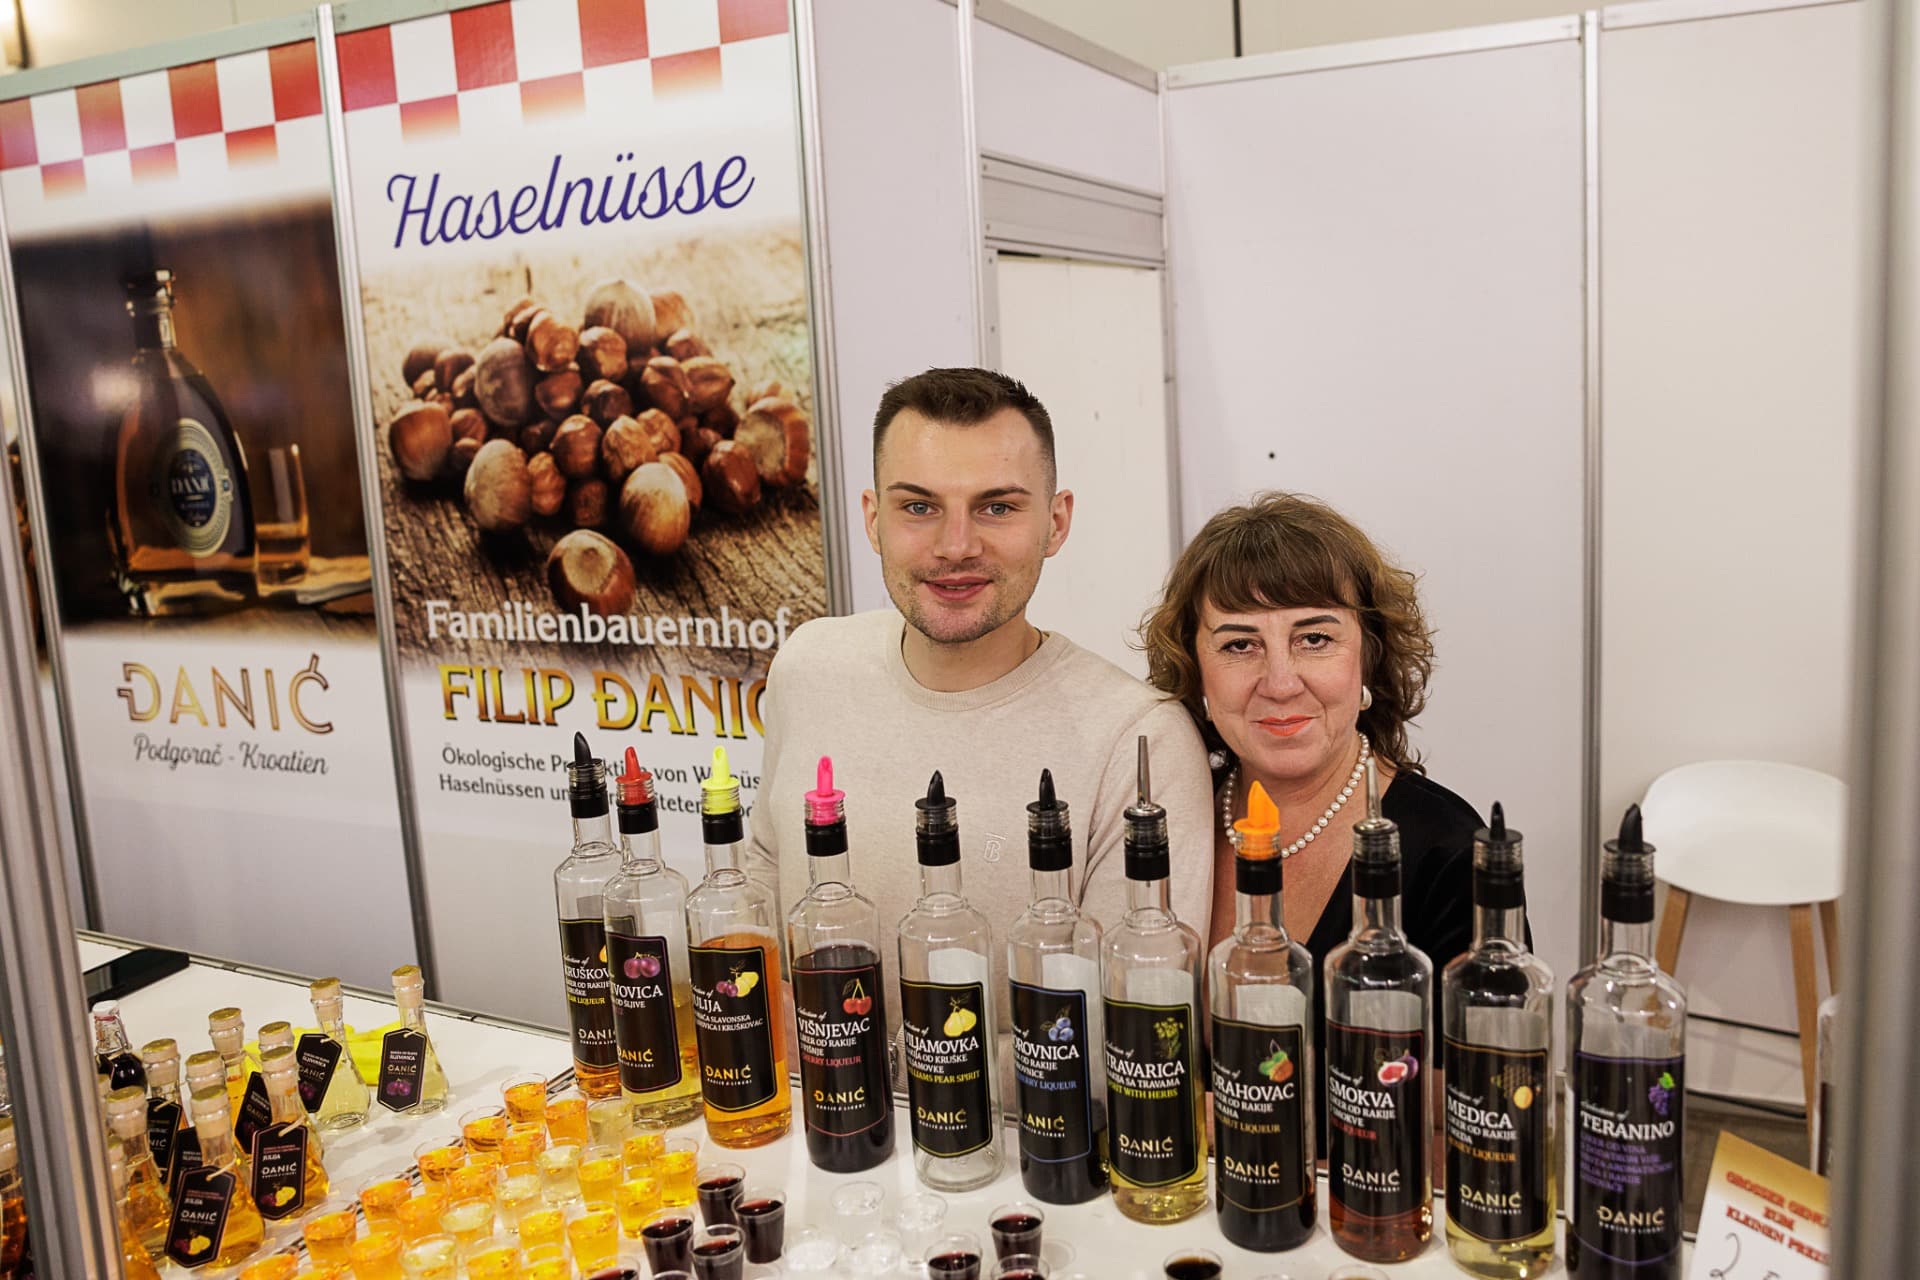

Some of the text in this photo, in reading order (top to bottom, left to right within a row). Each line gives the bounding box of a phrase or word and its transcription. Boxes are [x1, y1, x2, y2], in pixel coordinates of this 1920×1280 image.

[387, 152, 755, 248] Haselnüsse
[425, 600, 792, 650] Familienbauernhof
[117, 653, 334, 735] ĐANIĆ
[438, 664, 575, 727] FILIP
[134, 733, 223, 770] Podgorač
[239, 741, 329, 775] Kroatien
[442, 744, 546, 773] Ökologische
[654, 767, 688, 783] von
[440, 774, 544, 799] Haselnüssen
[550, 786, 570, 801] un
[565, 966, 610, 980] KRUŠKOV
[613, 983, 664, 999] VOVICA
[694, 993, 722, 1014] ULIJA
[798, 1017, 871, 1040] VIŠNJEVAC
[829, 1037, 857, 1048] RAKIJE
[1013, 1035, 1080, 1060] OROVNICA
[826, 1056, 862, 1068] LIQUEUR
[923, 1053, 934, 1063] OD
[1030, 1058, 1058, 1071] RAKIJE
[1106, 1051, 1185, 1079] TRAVARICA
[705, 1064, 752, 1080] ĐANIĆ
[934, 1074, 955, 1083] PEAR
[957, 1069, 981, 1082] SPIRIT
[1039, 1081, 1077, 1092] LIQUEUR
[1137, 1077, 1181, 1089] TRAVAMA
[814, 1086, 866, 1104] ĐANIĆ
[1123, 1086, 1146, 1099] WITH
[1148, 1087, 1179, 1100] HERBS
[1329, 1077, 1395, 1109] SMOKVA
[917, 1106, 968, 1124] ĐANIĆ
[1241, 1101, 1273, 1113] RAKIJE
[1348, 1103, 1361, 1115] OD
[1362, 1108, 1397, 1120] RAKIJE
[1448, 1095, 1513, 1129] MEDICA
[1026, 1113, 1065, 1131] ANIĆ
[1240, 1123, 1281, 1134] LIQUEUR
[1580, 1110, 1675, 1140] TERANINO
[1467, 1124, 1481, 1136] OD
[1482, 1129, 1517, 1141] RAKIJE
[1119, 1134, 1174, 1154] ĐANIĆ
[1472, 1147, 1516, 1162] LIQUEUR
[262, 1162, 297, 1175] ĐANIĆ
[1224, 1156, 1281, 1178] ĐANIĆ
[1342, 1163, 1400, 1186] ĐANIĆ
[1460, 1183, 1522, 1208] ĐANIĆ
[1597, 1205, 1664, 1226] ĐANIĆ
[1726, 1206, 1784, 1243] KLEINEN
